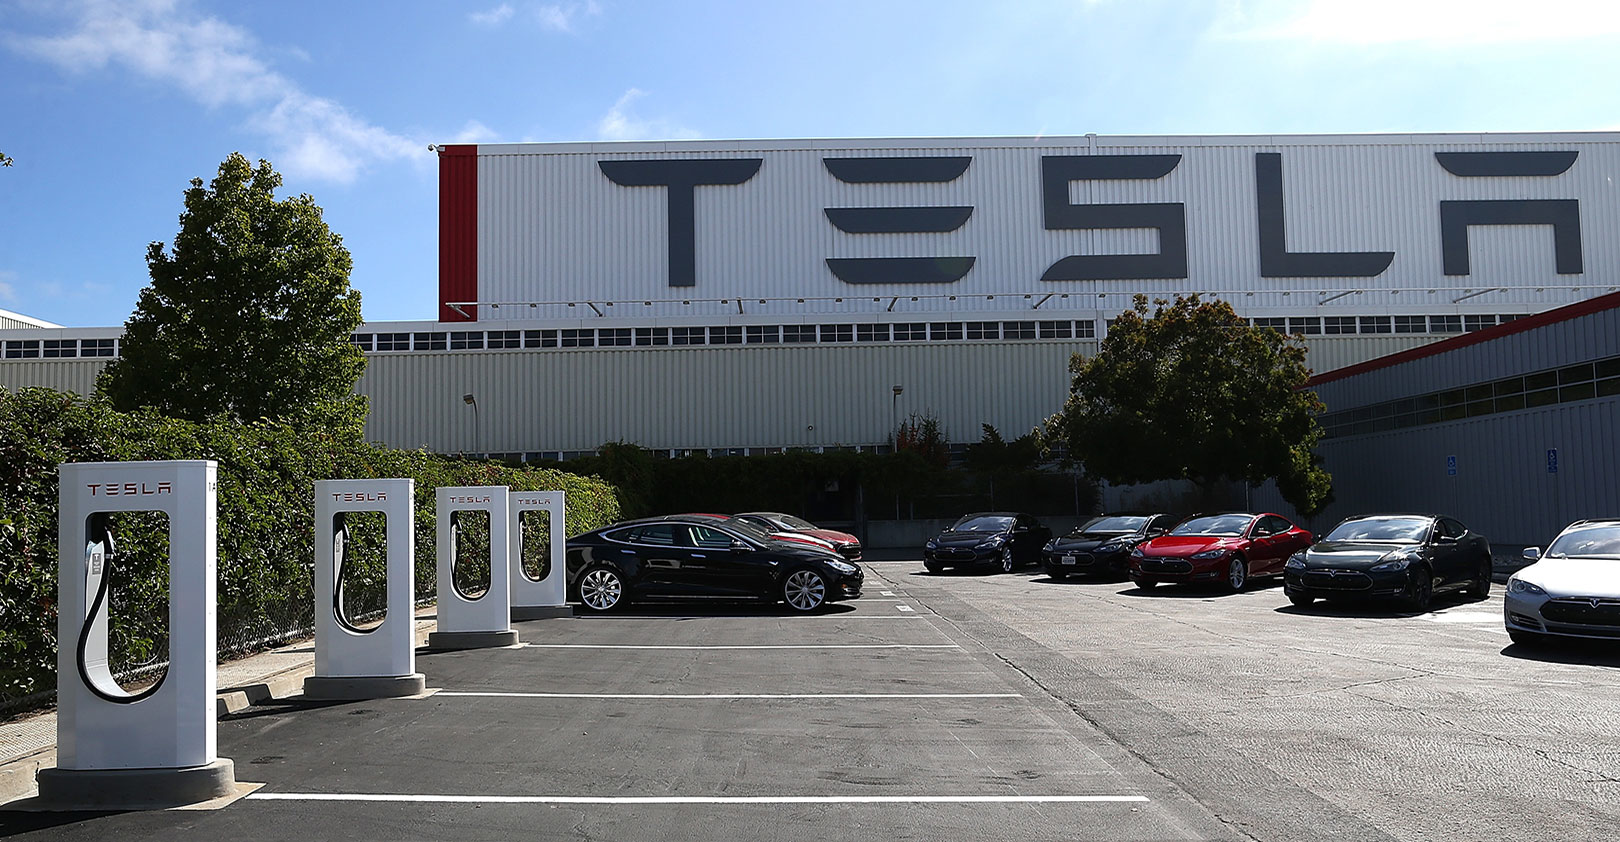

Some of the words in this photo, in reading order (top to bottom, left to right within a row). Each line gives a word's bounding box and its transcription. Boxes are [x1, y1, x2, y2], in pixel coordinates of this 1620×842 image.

[598, 151, 1584, 287] TESLA
[87, 482, 171, 496] TESLA
[332, 492, 386, 502] TESLA
[449, 496, 491, 504] TESLA
